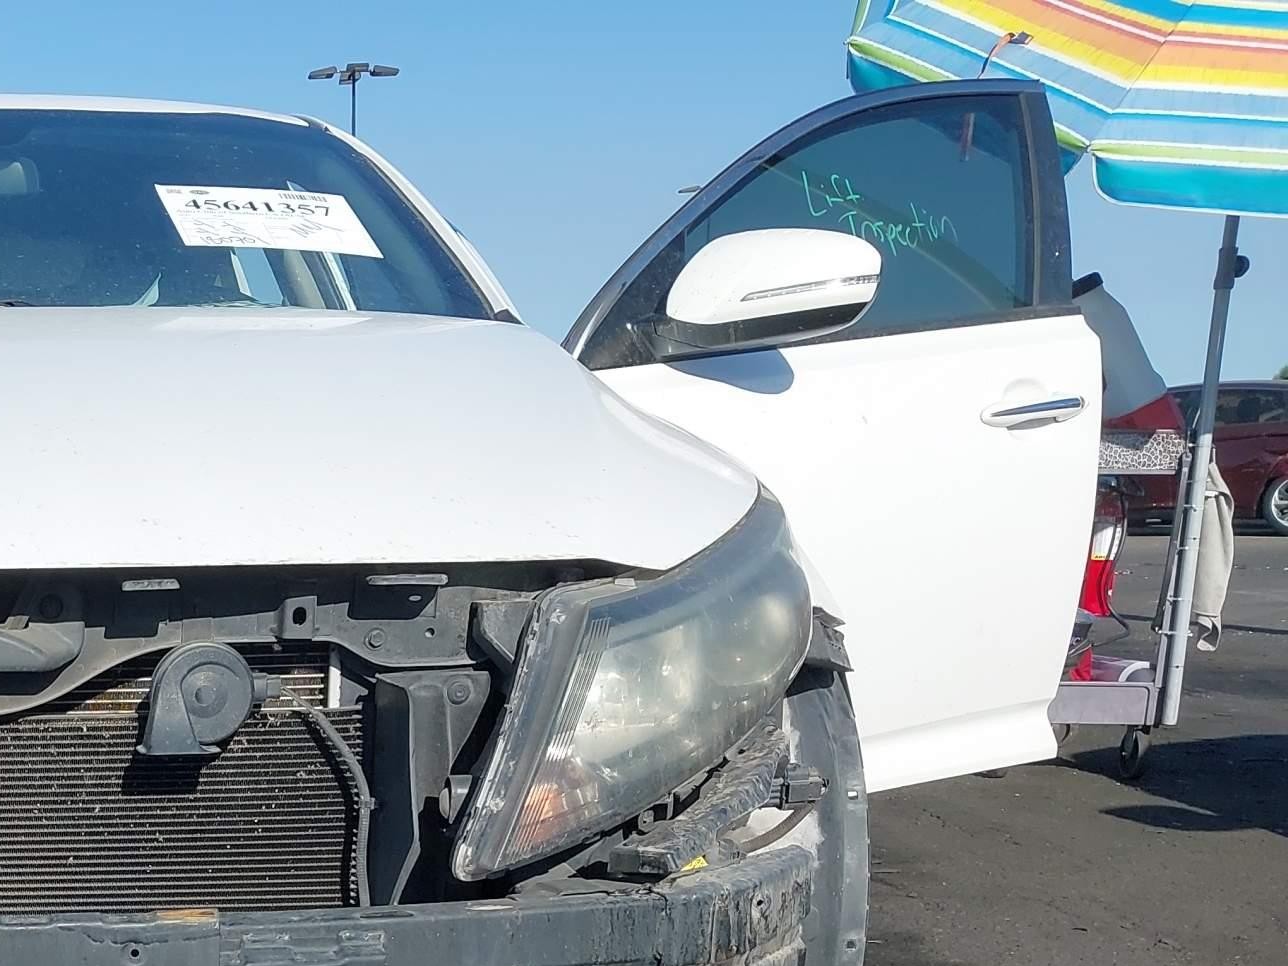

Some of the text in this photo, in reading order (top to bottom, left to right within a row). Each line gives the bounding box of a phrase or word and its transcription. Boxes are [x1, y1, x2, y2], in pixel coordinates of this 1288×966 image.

[184, 198, 331, 217] 45641357
[801, 170, 861, 216] Lift
[838, 201, 958, 256] Inspection
